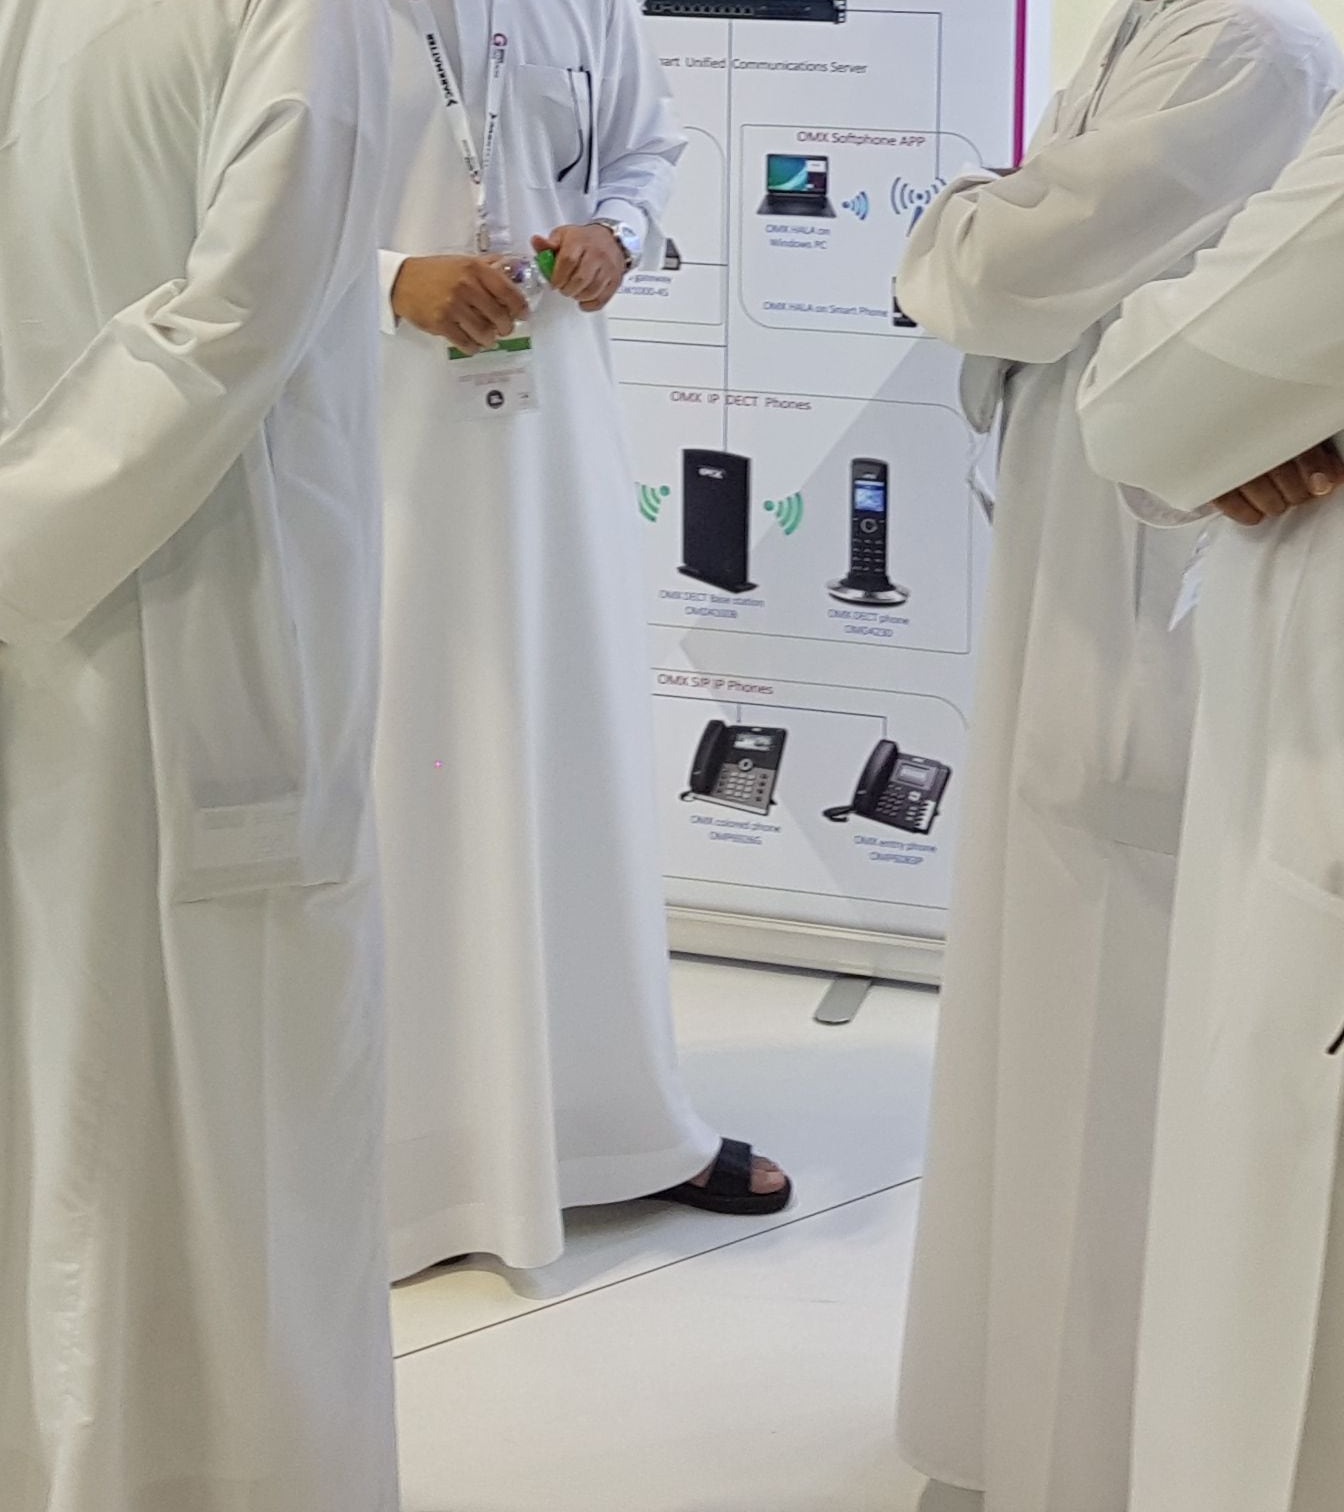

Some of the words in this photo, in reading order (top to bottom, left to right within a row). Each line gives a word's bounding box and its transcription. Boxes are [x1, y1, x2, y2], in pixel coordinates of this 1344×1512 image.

[685, 56, 726, 69] Unified
[732, 58, 829, 73] Communications
[830, 61, 868, 74] Server
[796, 131, 831, 143] OMX
[832, 131, 897, 147] Softphone
[899, 136, 926, 148] APP
[670, 390, 702, 403] OMX
[707, 393, 719, 404] IP
[725, 394, 758, 407] DECT
[764, 397, 812, 410] Phones
[657, 673, 688, 686] OMX
[690, 675, 710, 688] SIP
[727, 679, 775, 695] Phones
